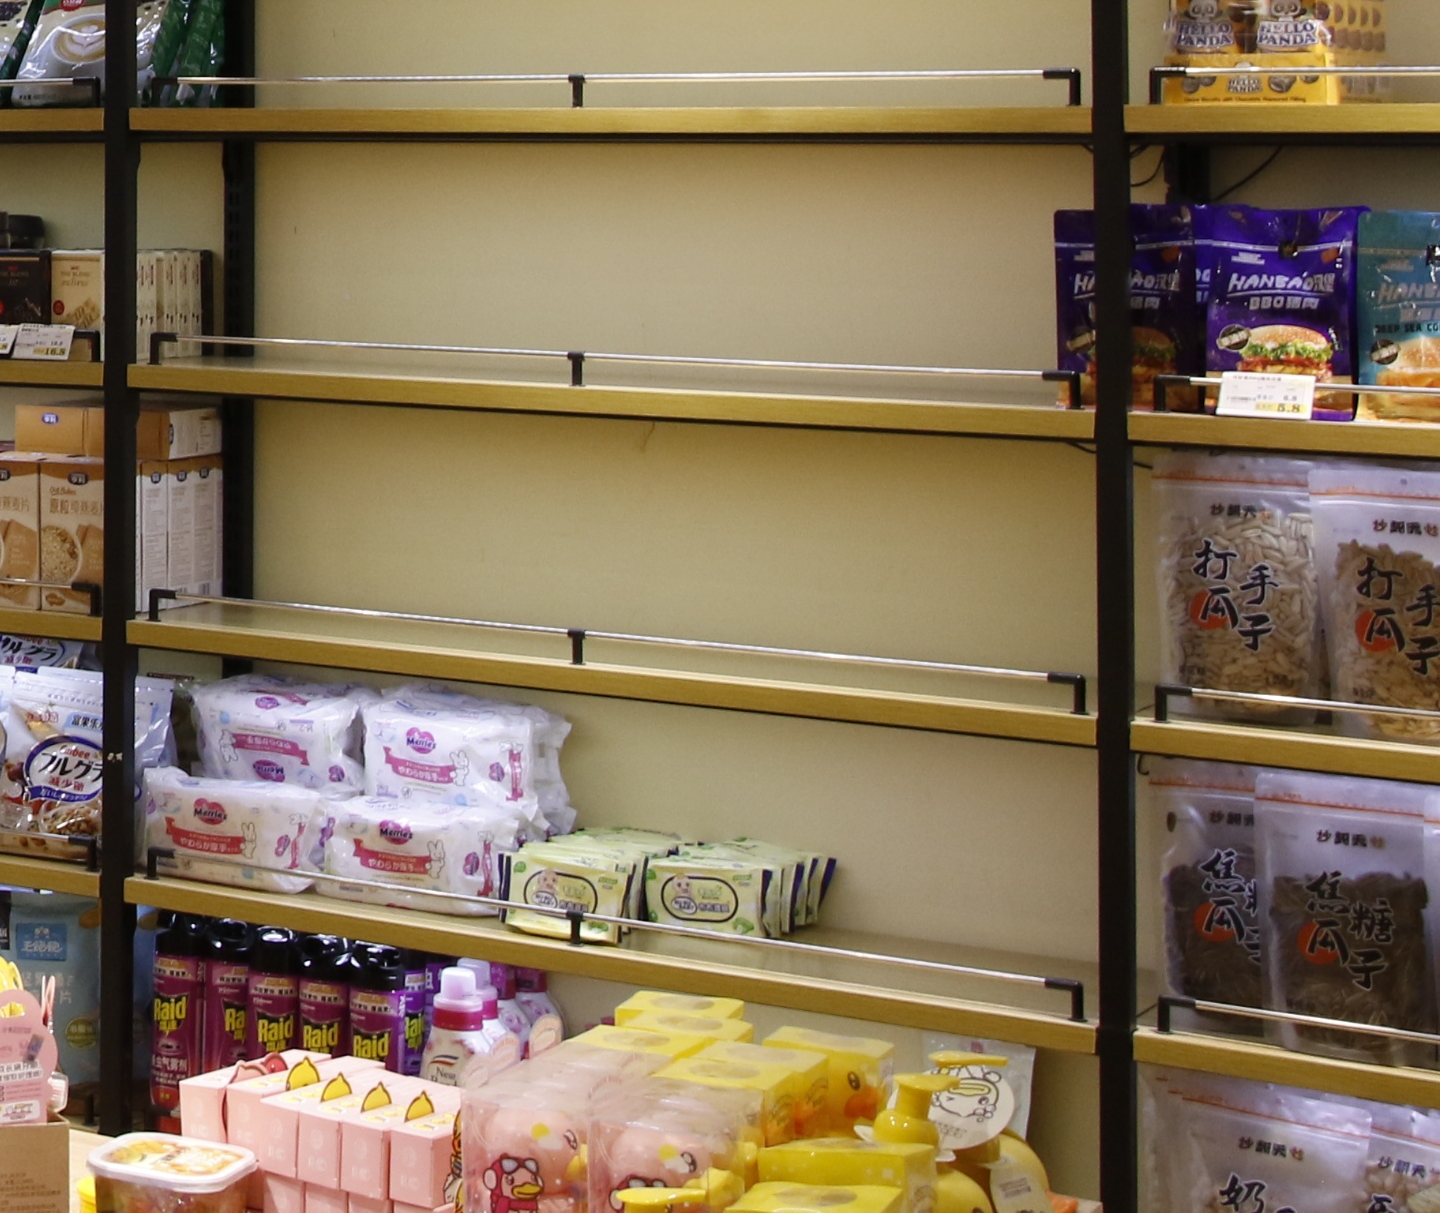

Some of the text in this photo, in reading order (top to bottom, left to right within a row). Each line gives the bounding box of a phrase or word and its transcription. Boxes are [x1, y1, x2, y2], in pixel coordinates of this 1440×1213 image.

[1175, 20, 1234, 37] HELLO
[1258, 18, 1317, 36] HELLO
[1176, 33, 1235, 49] PANDA
[1257, 30, 1319, 48] PANDA
[45, 347, 67, 356] 16.8
[1276, 402, 1301, 414] 5.8
[406, 735, 438, 752] Merries
[60, 745, 92, 760] Calbee
[192, 806, 229, 823] Merries
[379, 826, 414, 842] Merries
[153, 994, 188, 1023] Raid
[256, 1015, 295, 1044] Raid
[302, 1020, 340, 1050] Raid
[353, 1030, 391, 1060] Raid
[436, 1066, 457, 1079] New
